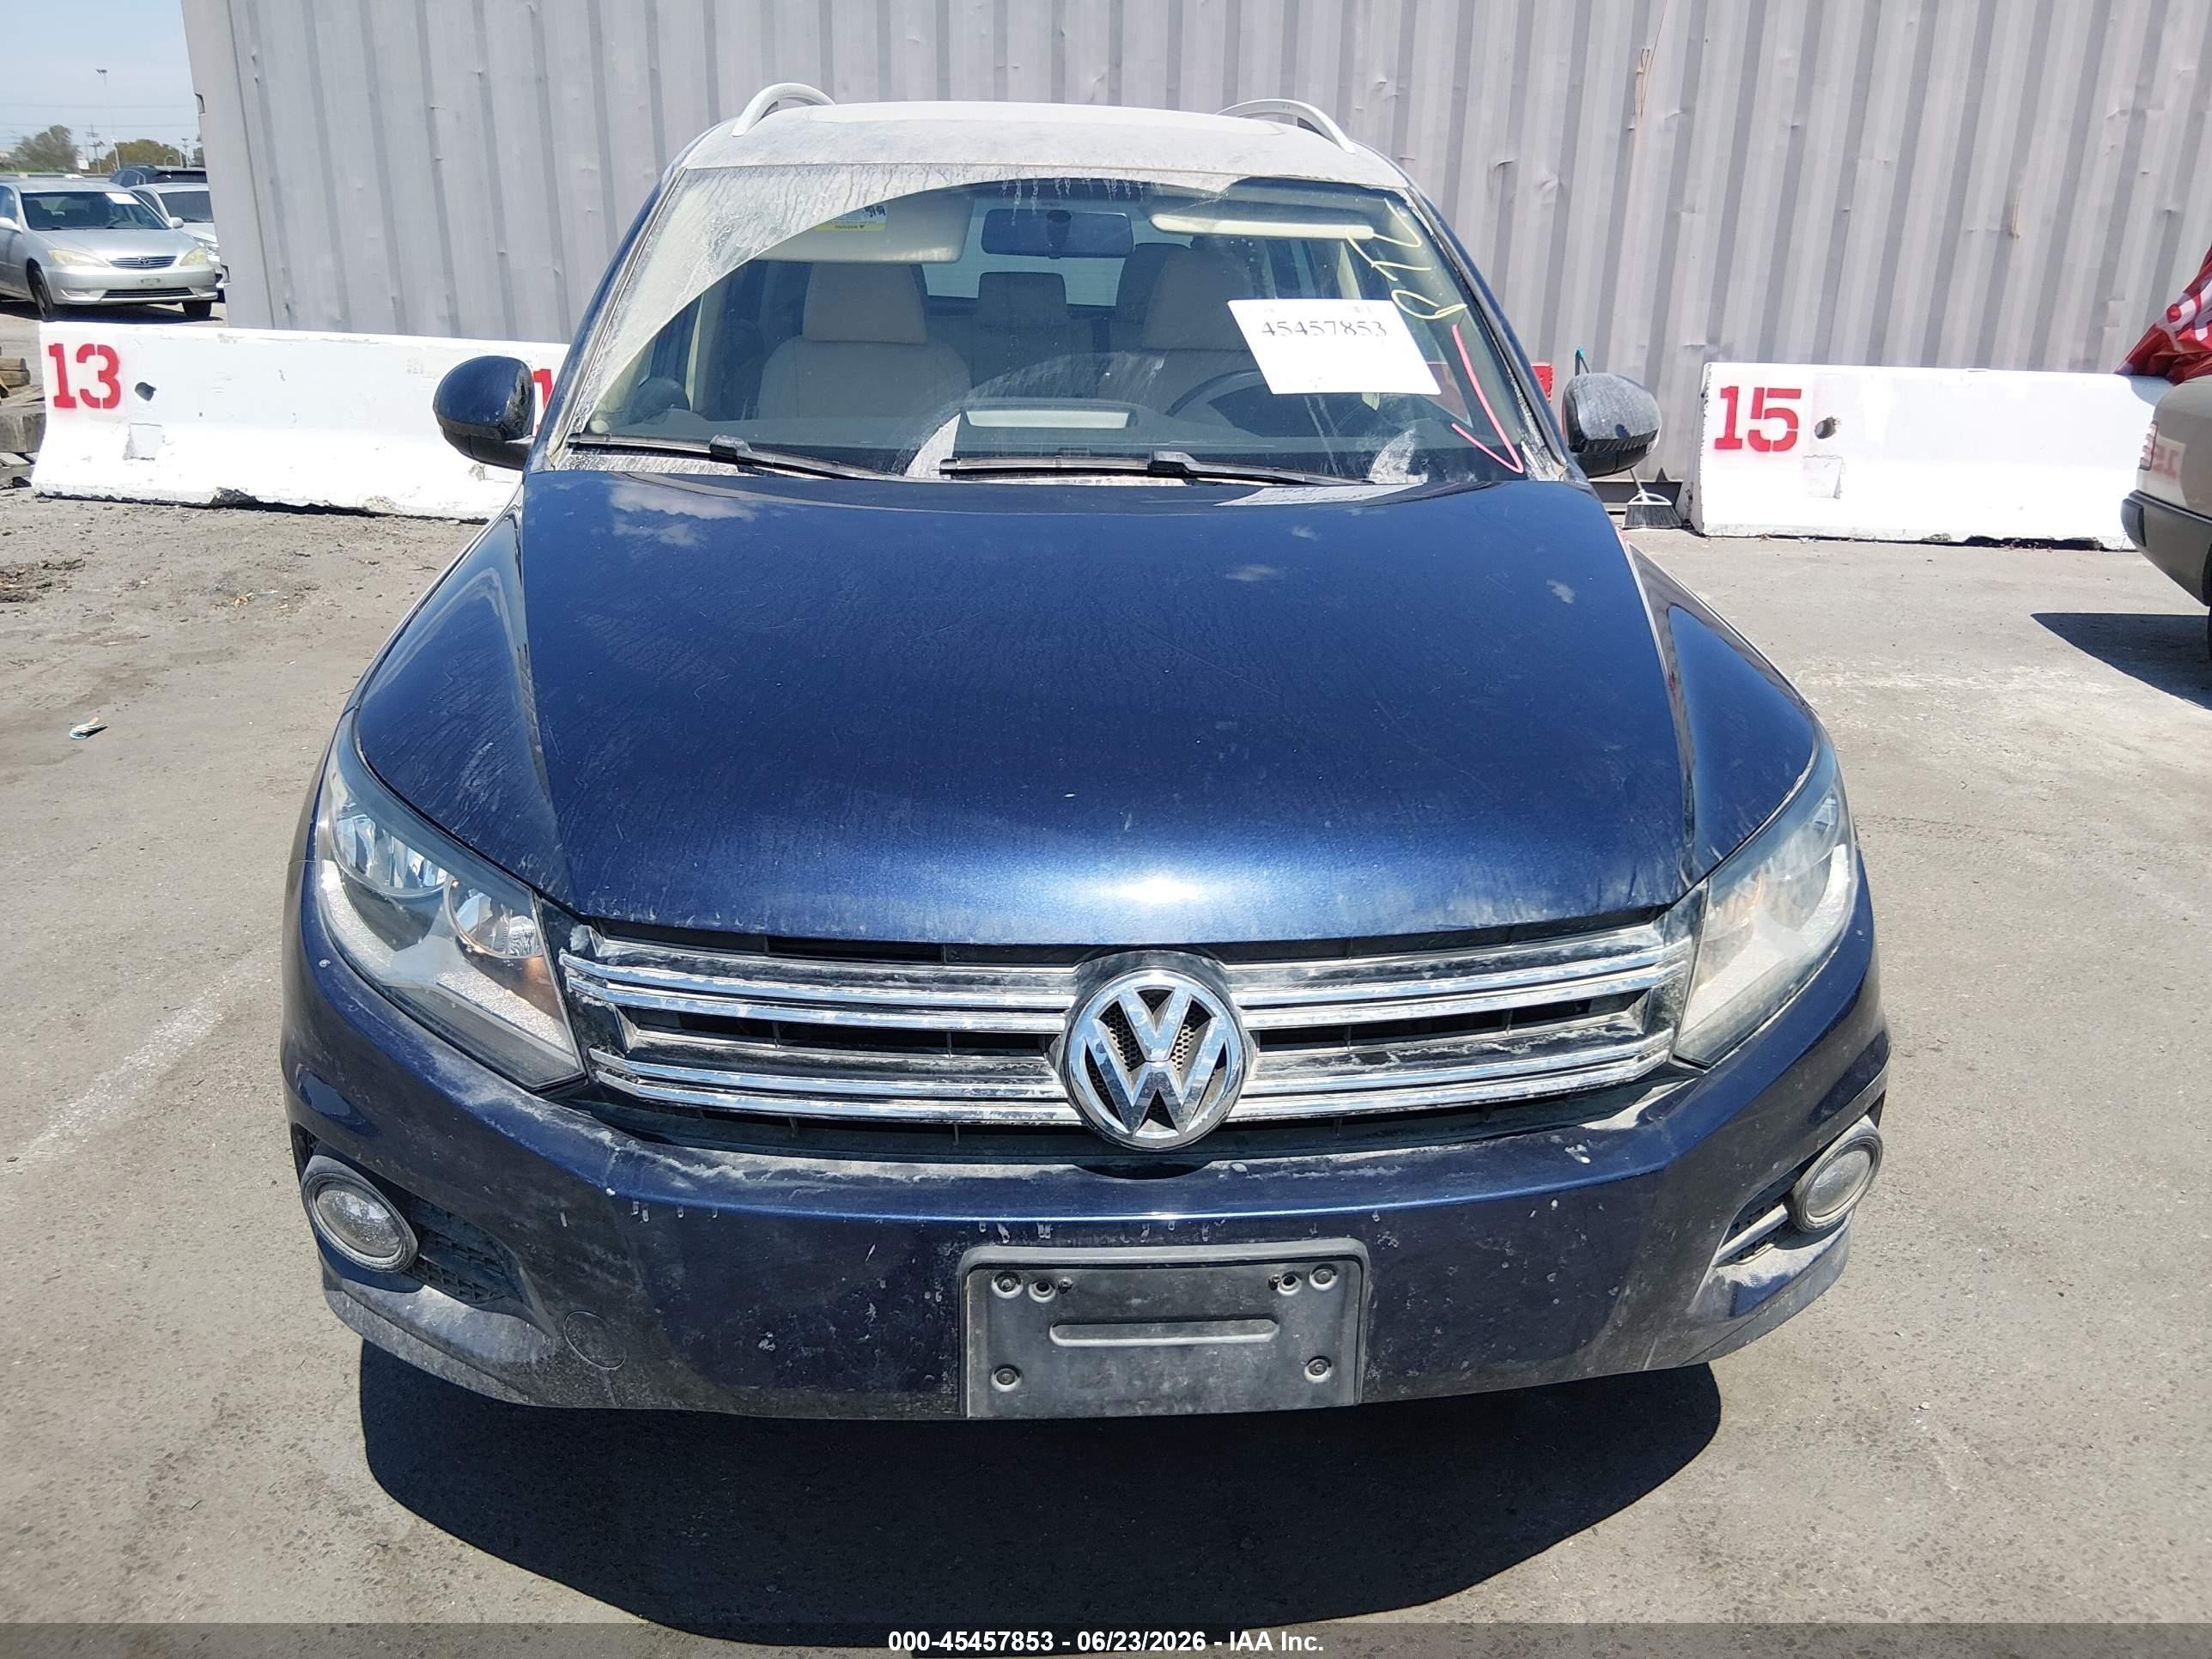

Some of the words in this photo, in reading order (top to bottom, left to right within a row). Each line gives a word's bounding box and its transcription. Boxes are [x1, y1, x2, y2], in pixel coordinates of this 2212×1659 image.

[1261, 320, 1387, 337] 45457853
[48, 343, 121, 409] 13
[1714, 386, 1802, 453] 15
